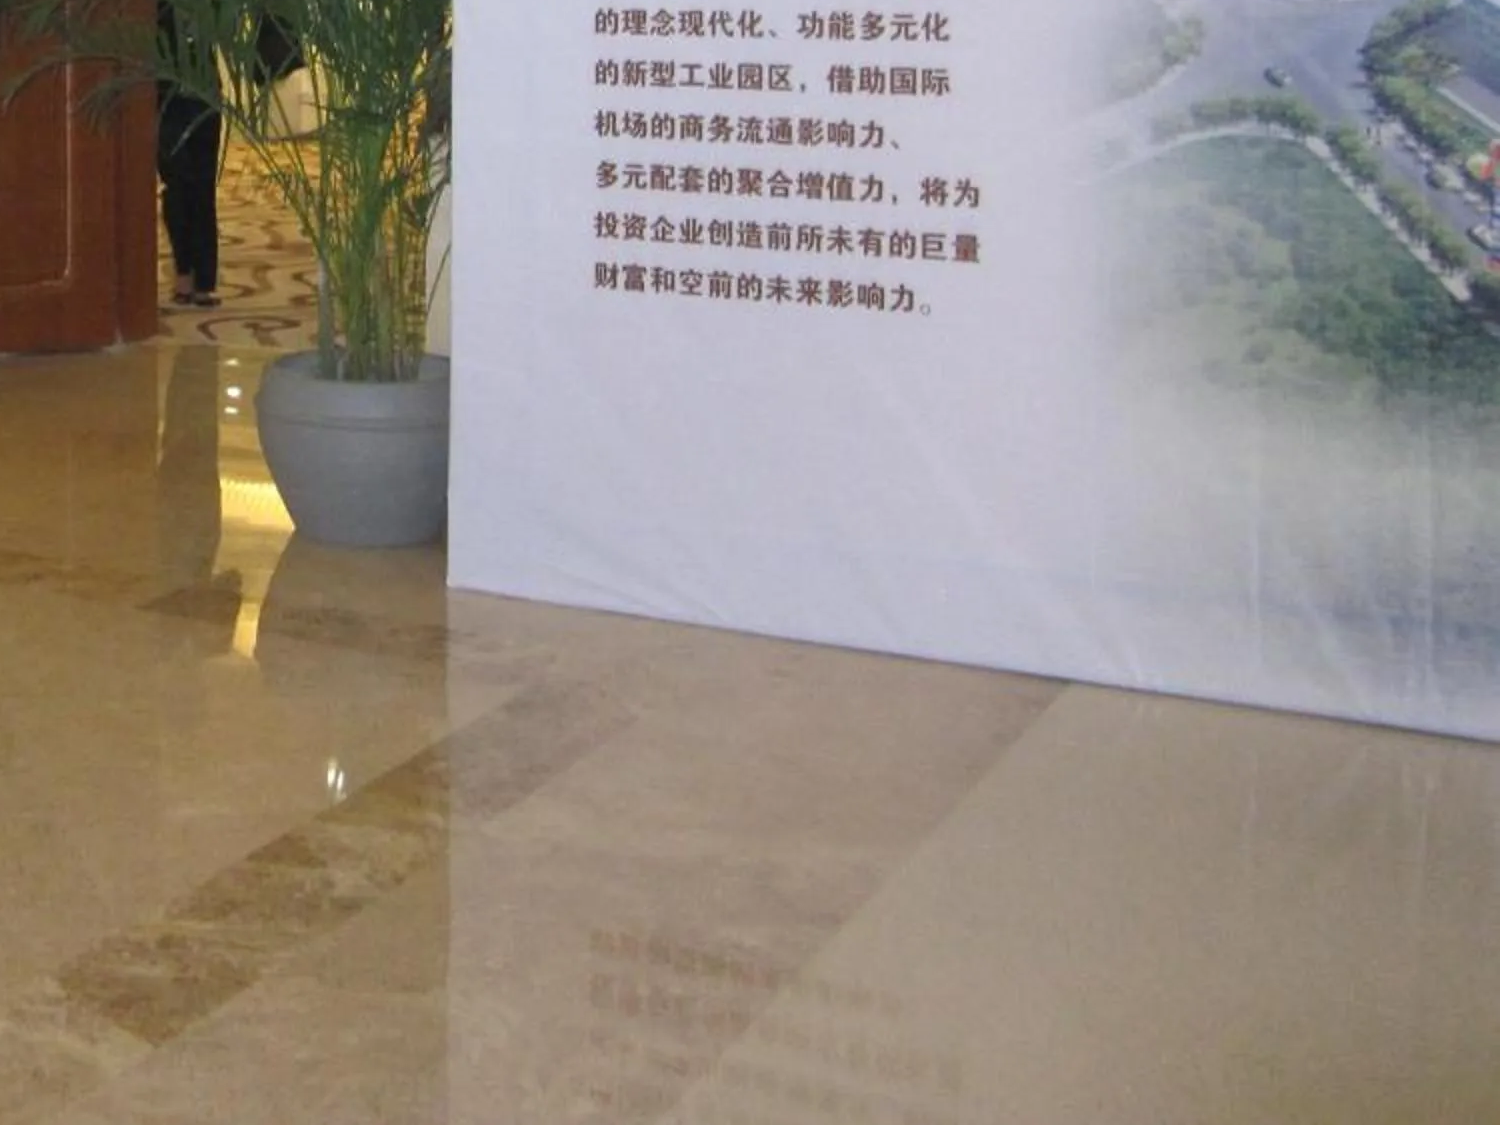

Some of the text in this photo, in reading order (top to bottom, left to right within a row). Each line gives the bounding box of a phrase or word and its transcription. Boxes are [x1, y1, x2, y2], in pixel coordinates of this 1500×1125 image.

[594, 8, 951, 43] 的理念现代化、功能多元化
[594, 58, 952, 97] 的新型工业园区，借助国际
[594, 109, 900, 151] 机场的商务流通影响力、
[596, 161, 980, 209] 多元配套的聚合增值力，将为
[594, 211, 980, 264] 投资企业创造前所未有的巨量
[594, 262, 932, 317] 财富和空前的未来影响力。
